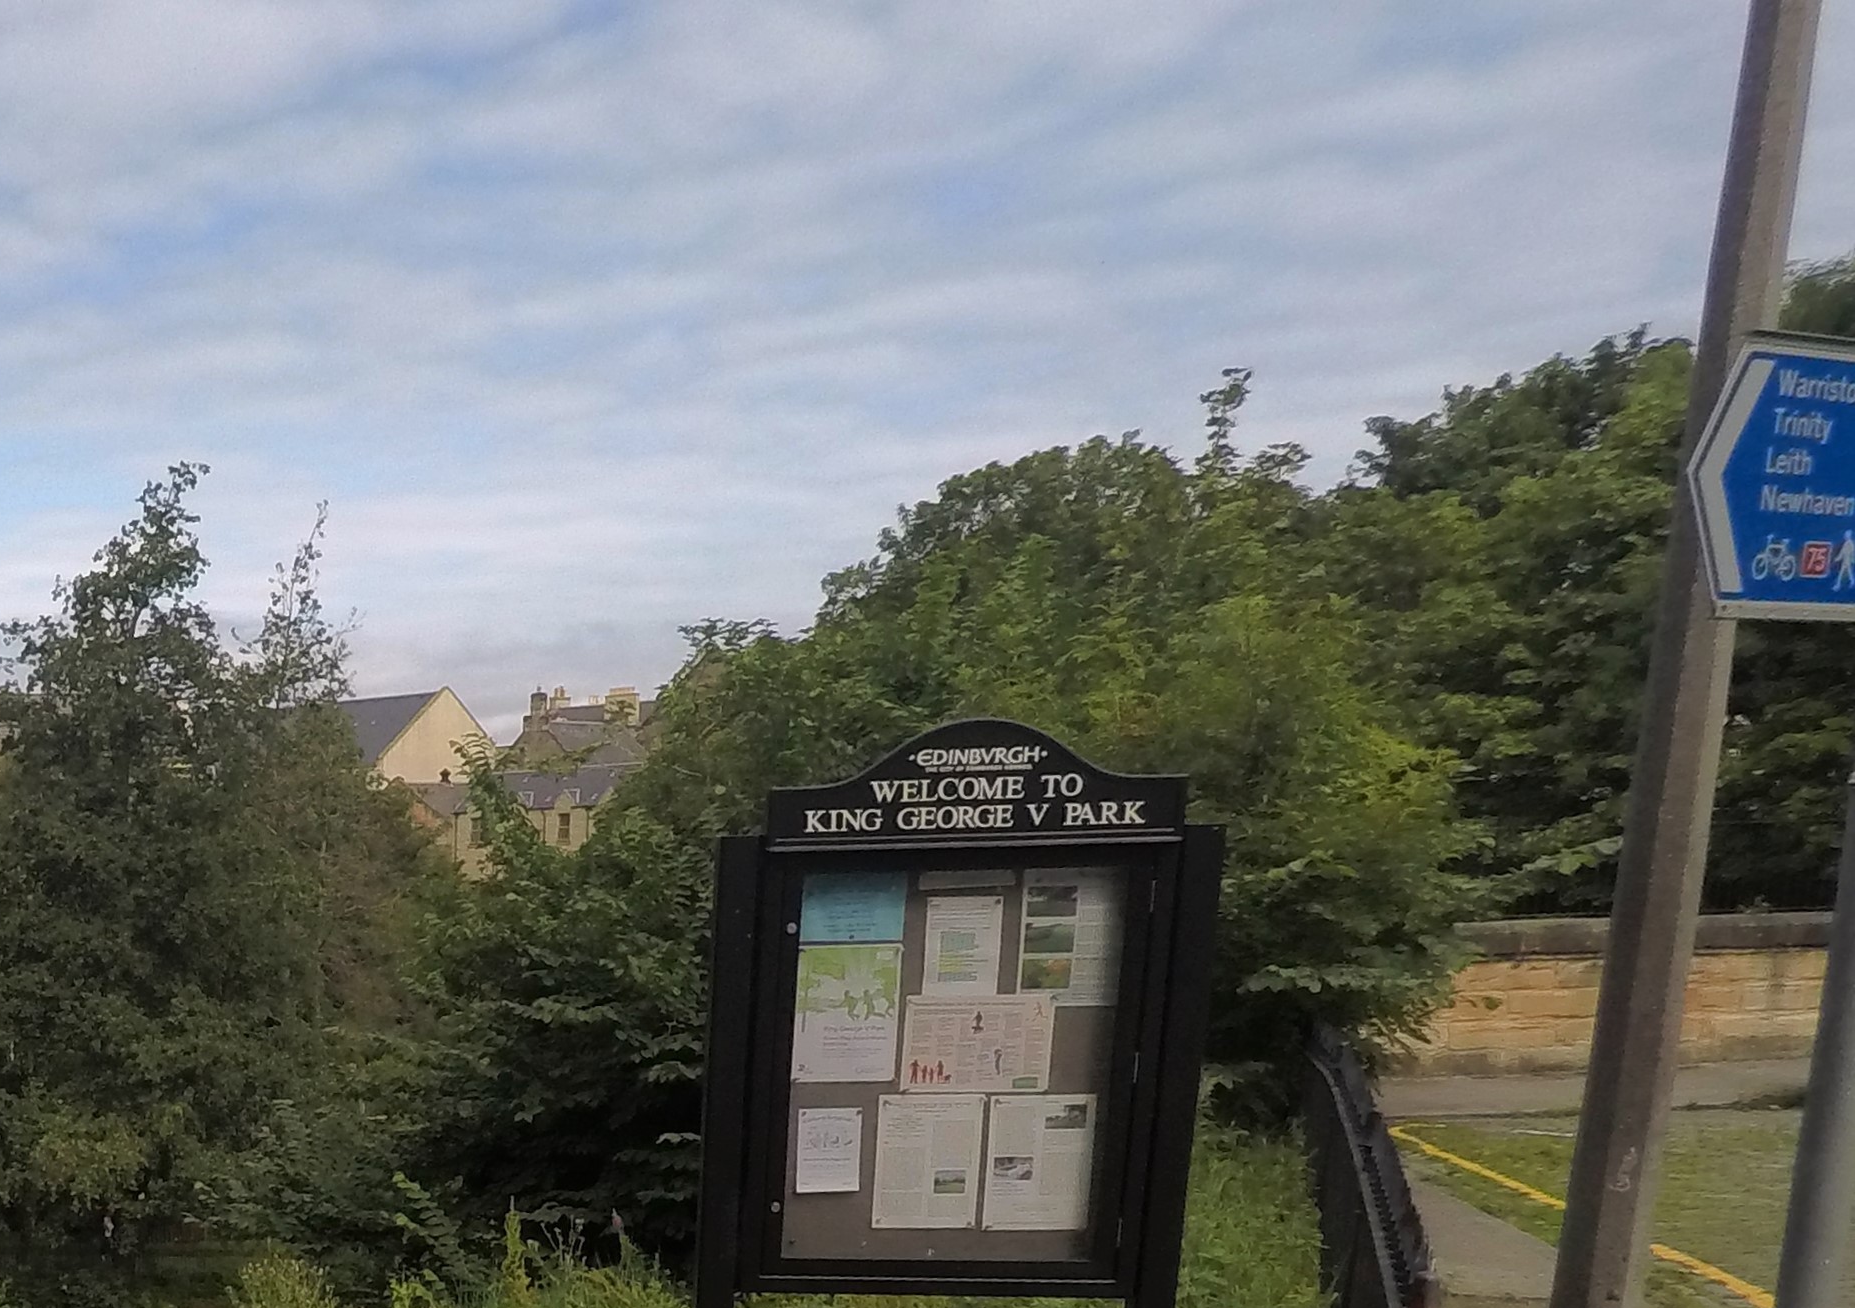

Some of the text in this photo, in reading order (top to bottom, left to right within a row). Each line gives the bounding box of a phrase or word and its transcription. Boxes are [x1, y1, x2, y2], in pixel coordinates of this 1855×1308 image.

[1779, 369, 1855, 404] Warristo
[1774, 408, 1833, 445] Trinity
[1766, 447, 1812, 476] Leith
[1760, 484, 1855, 516] Newhaven
[1808, 547, 1827, 571] 75
[870, 774, 1083, 803] WELCOME TO
[804, 801, 1146, 833] KING GEORGE V PARK
